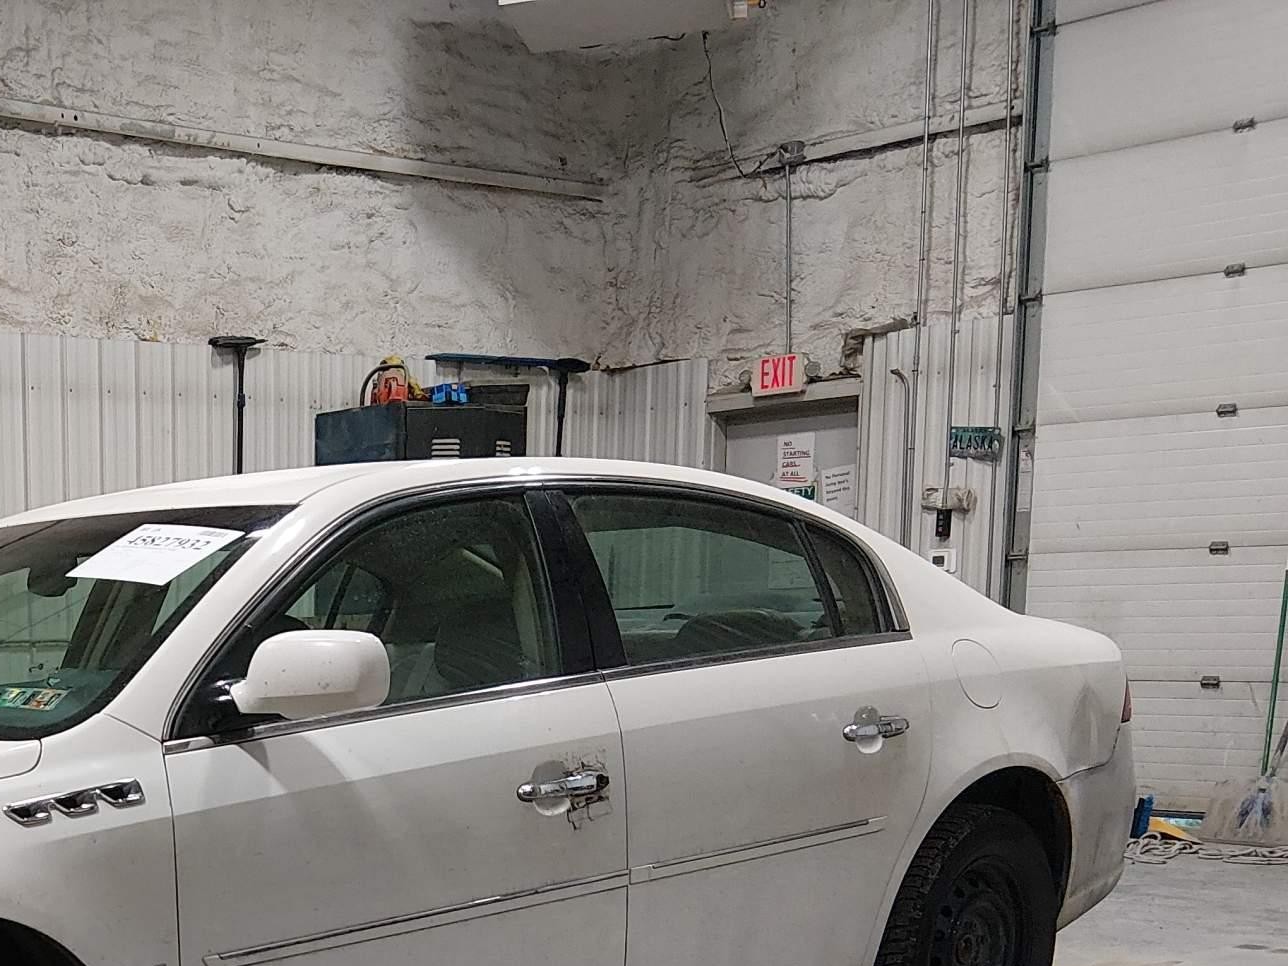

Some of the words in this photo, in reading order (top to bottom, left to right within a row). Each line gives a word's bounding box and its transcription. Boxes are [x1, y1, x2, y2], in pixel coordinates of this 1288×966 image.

[760, 355, 797, 390] EXIT
[951, 433, 994, 451] ALASKA
[783, 449, 810, 457] STARTING
[127, 535, 212, 551] 45827932
